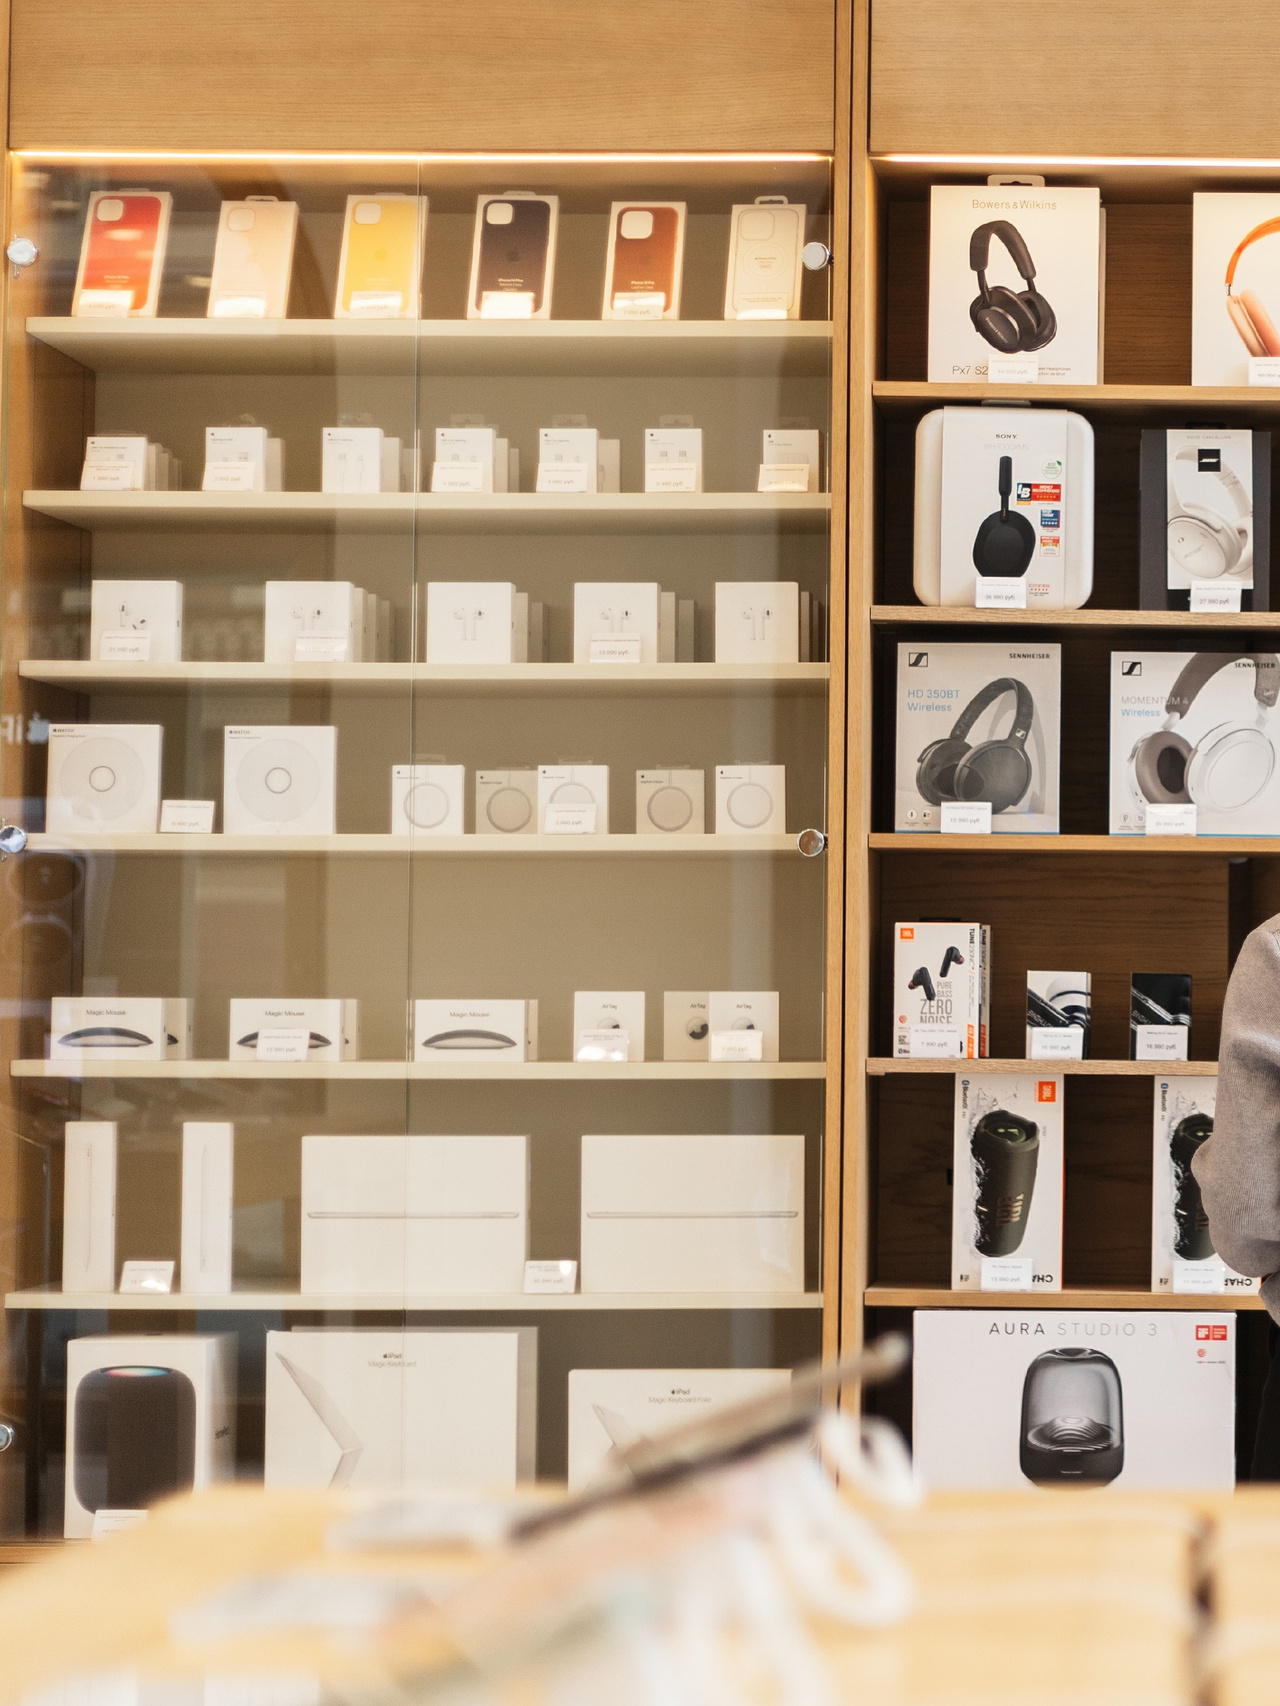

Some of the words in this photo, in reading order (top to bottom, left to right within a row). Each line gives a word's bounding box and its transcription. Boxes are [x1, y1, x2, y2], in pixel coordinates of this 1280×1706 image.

[972, 199, 1010, 210] Bowers
[1012, 201, 1018, 209] &
[1019, 200, 1057, 210] Wilkins
[952, 366, 971, 376] Px7
[974, 366, 988, 376] S2
[908, 690, 924, 698] HD
[926, 690, 960, 698] 350BT
[1121, 696, 1181, 705] MOMENTUM
[1183, 696, 1189, 705] 4
[907, 702, 952, 712] Wireless
[1121, 709, 1161, 717] Wireless
[937, 981, 953, 989] PURE
[936, 990, 953, 998] BASS
[920, 999, 953, 1015] ZERO
[86, 1009, 103, 1017] Magic
[920, 1016, 953, 1024] NOISE
[989, 1322, 1046, 1336] AURA
[1056, 1322, 1136, 1336] STUDIO
[1148, 1323, 1158, 1336] 3
